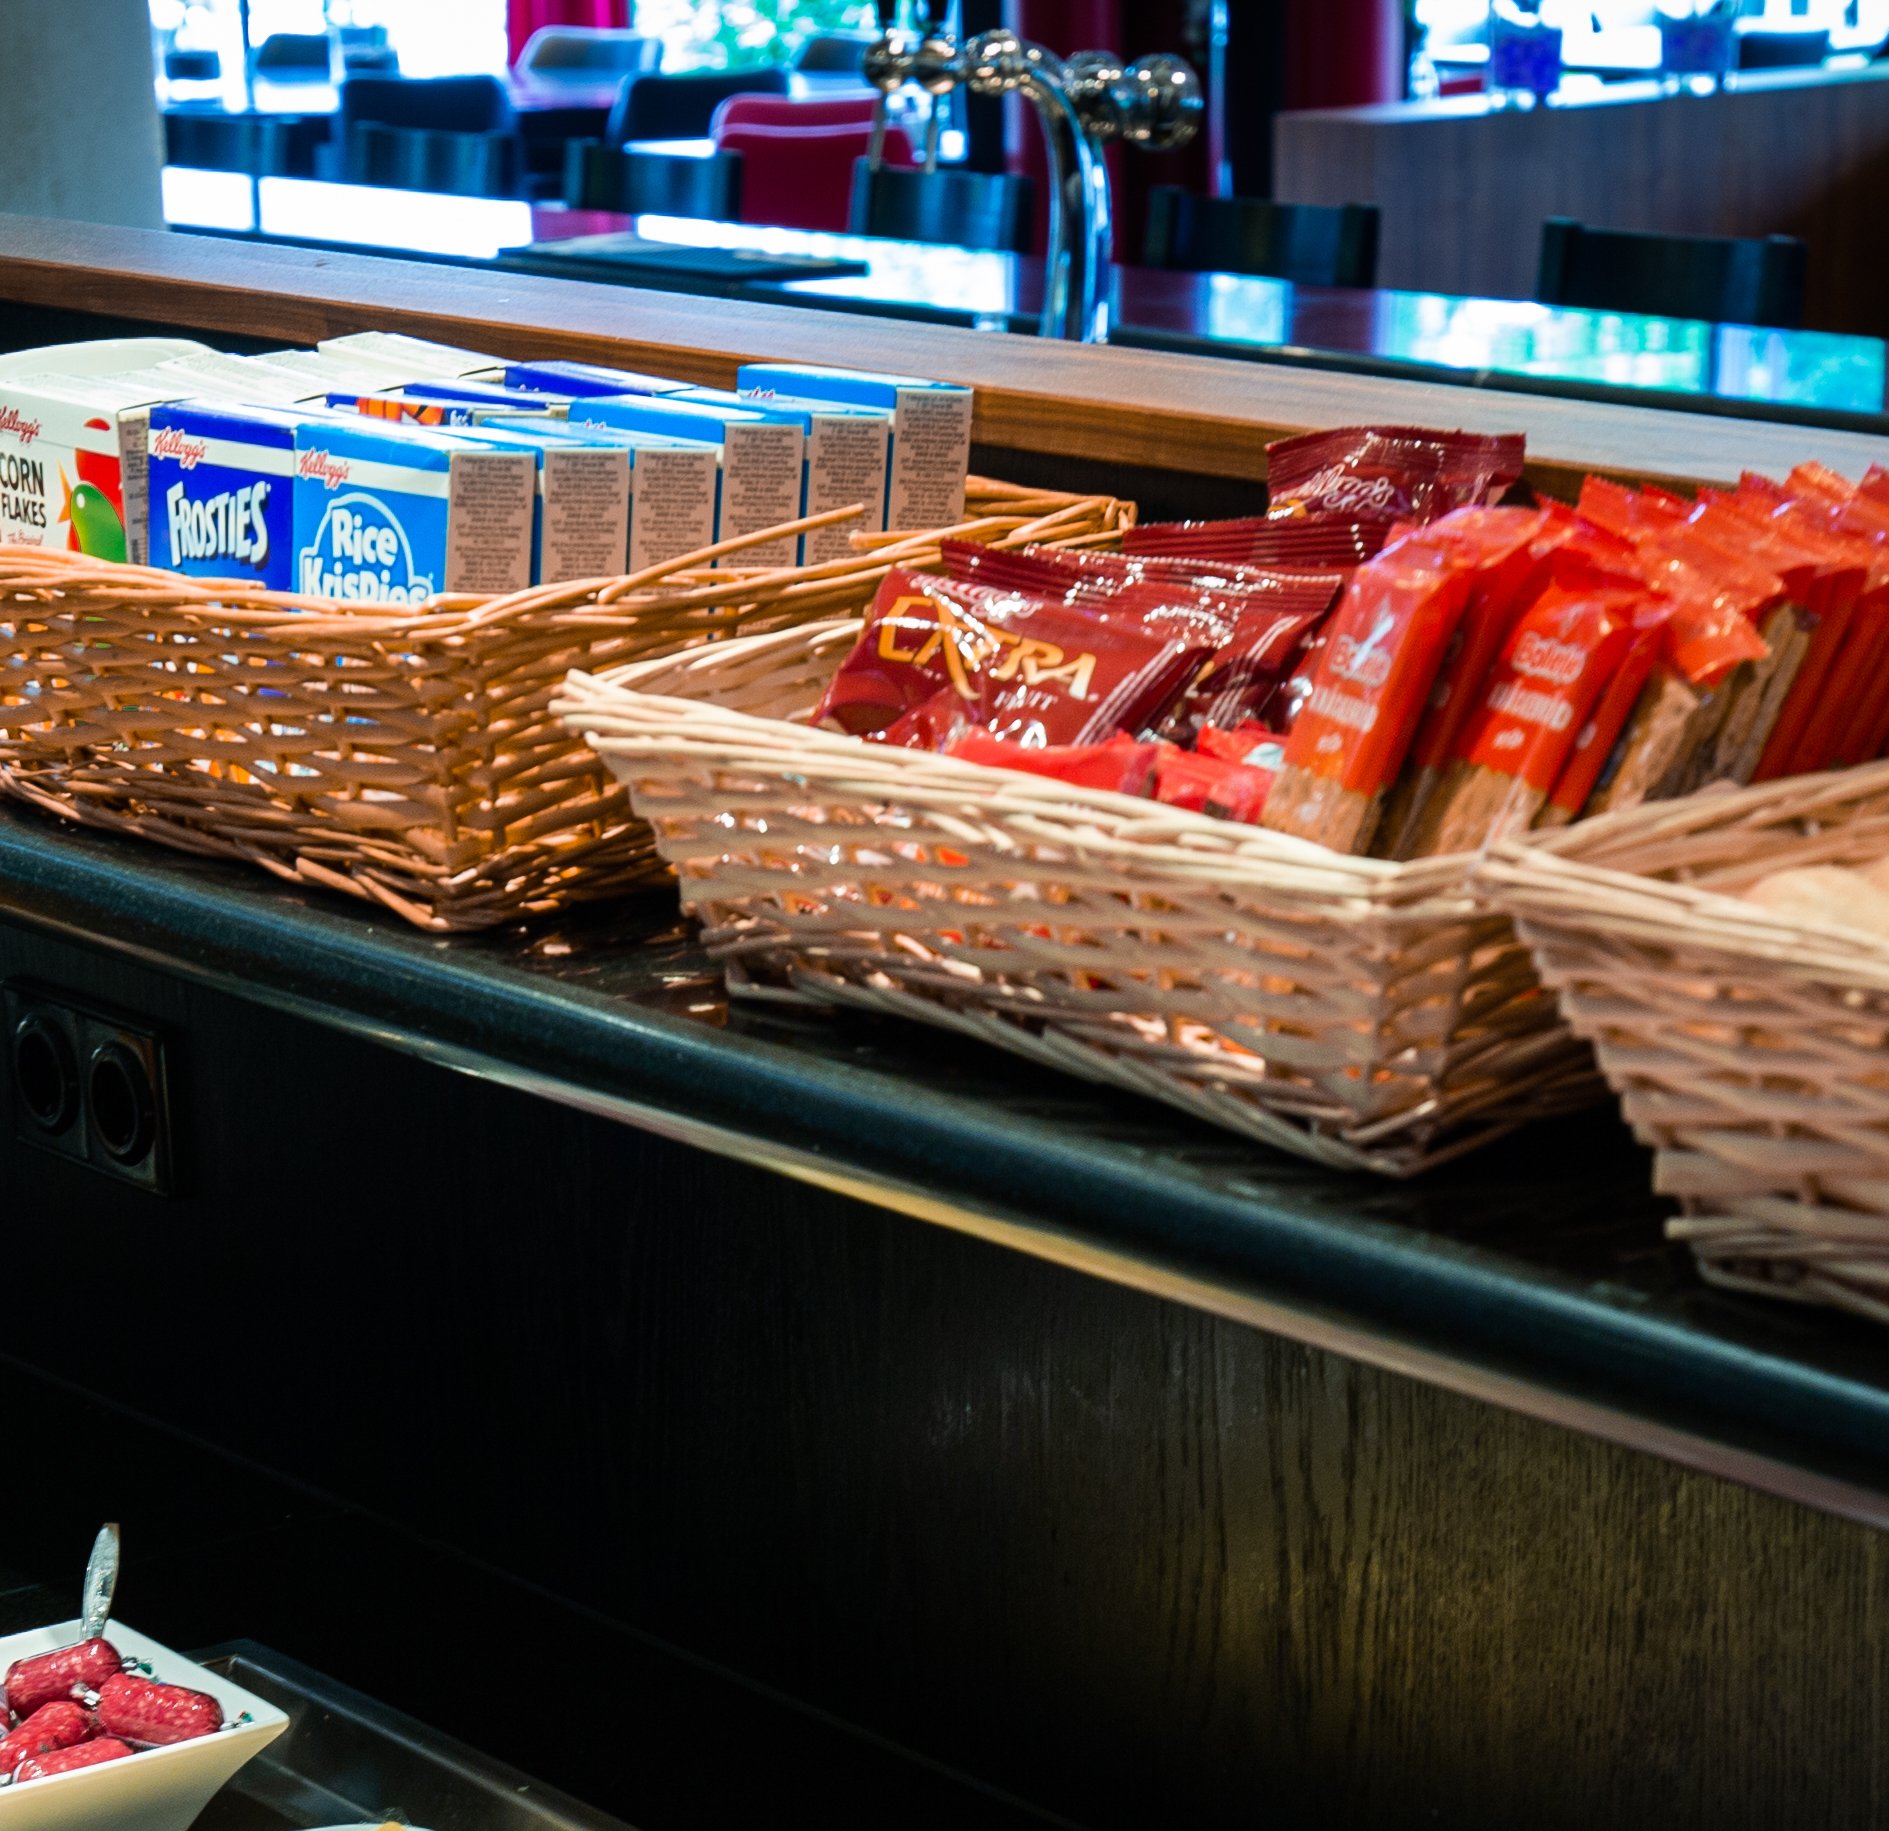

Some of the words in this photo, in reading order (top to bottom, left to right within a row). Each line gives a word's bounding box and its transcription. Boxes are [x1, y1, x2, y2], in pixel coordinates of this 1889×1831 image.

[154, 426, 208, 470] Kellogg's
[299, 447, 351, 490] Kellogg's
[0, 493, 47, 528] FLAKES
[166, 480, 269, 567] FROSTIES
[331, 508, 398, 567] Rice
[878, 596, 1097, 700] EXTRA
